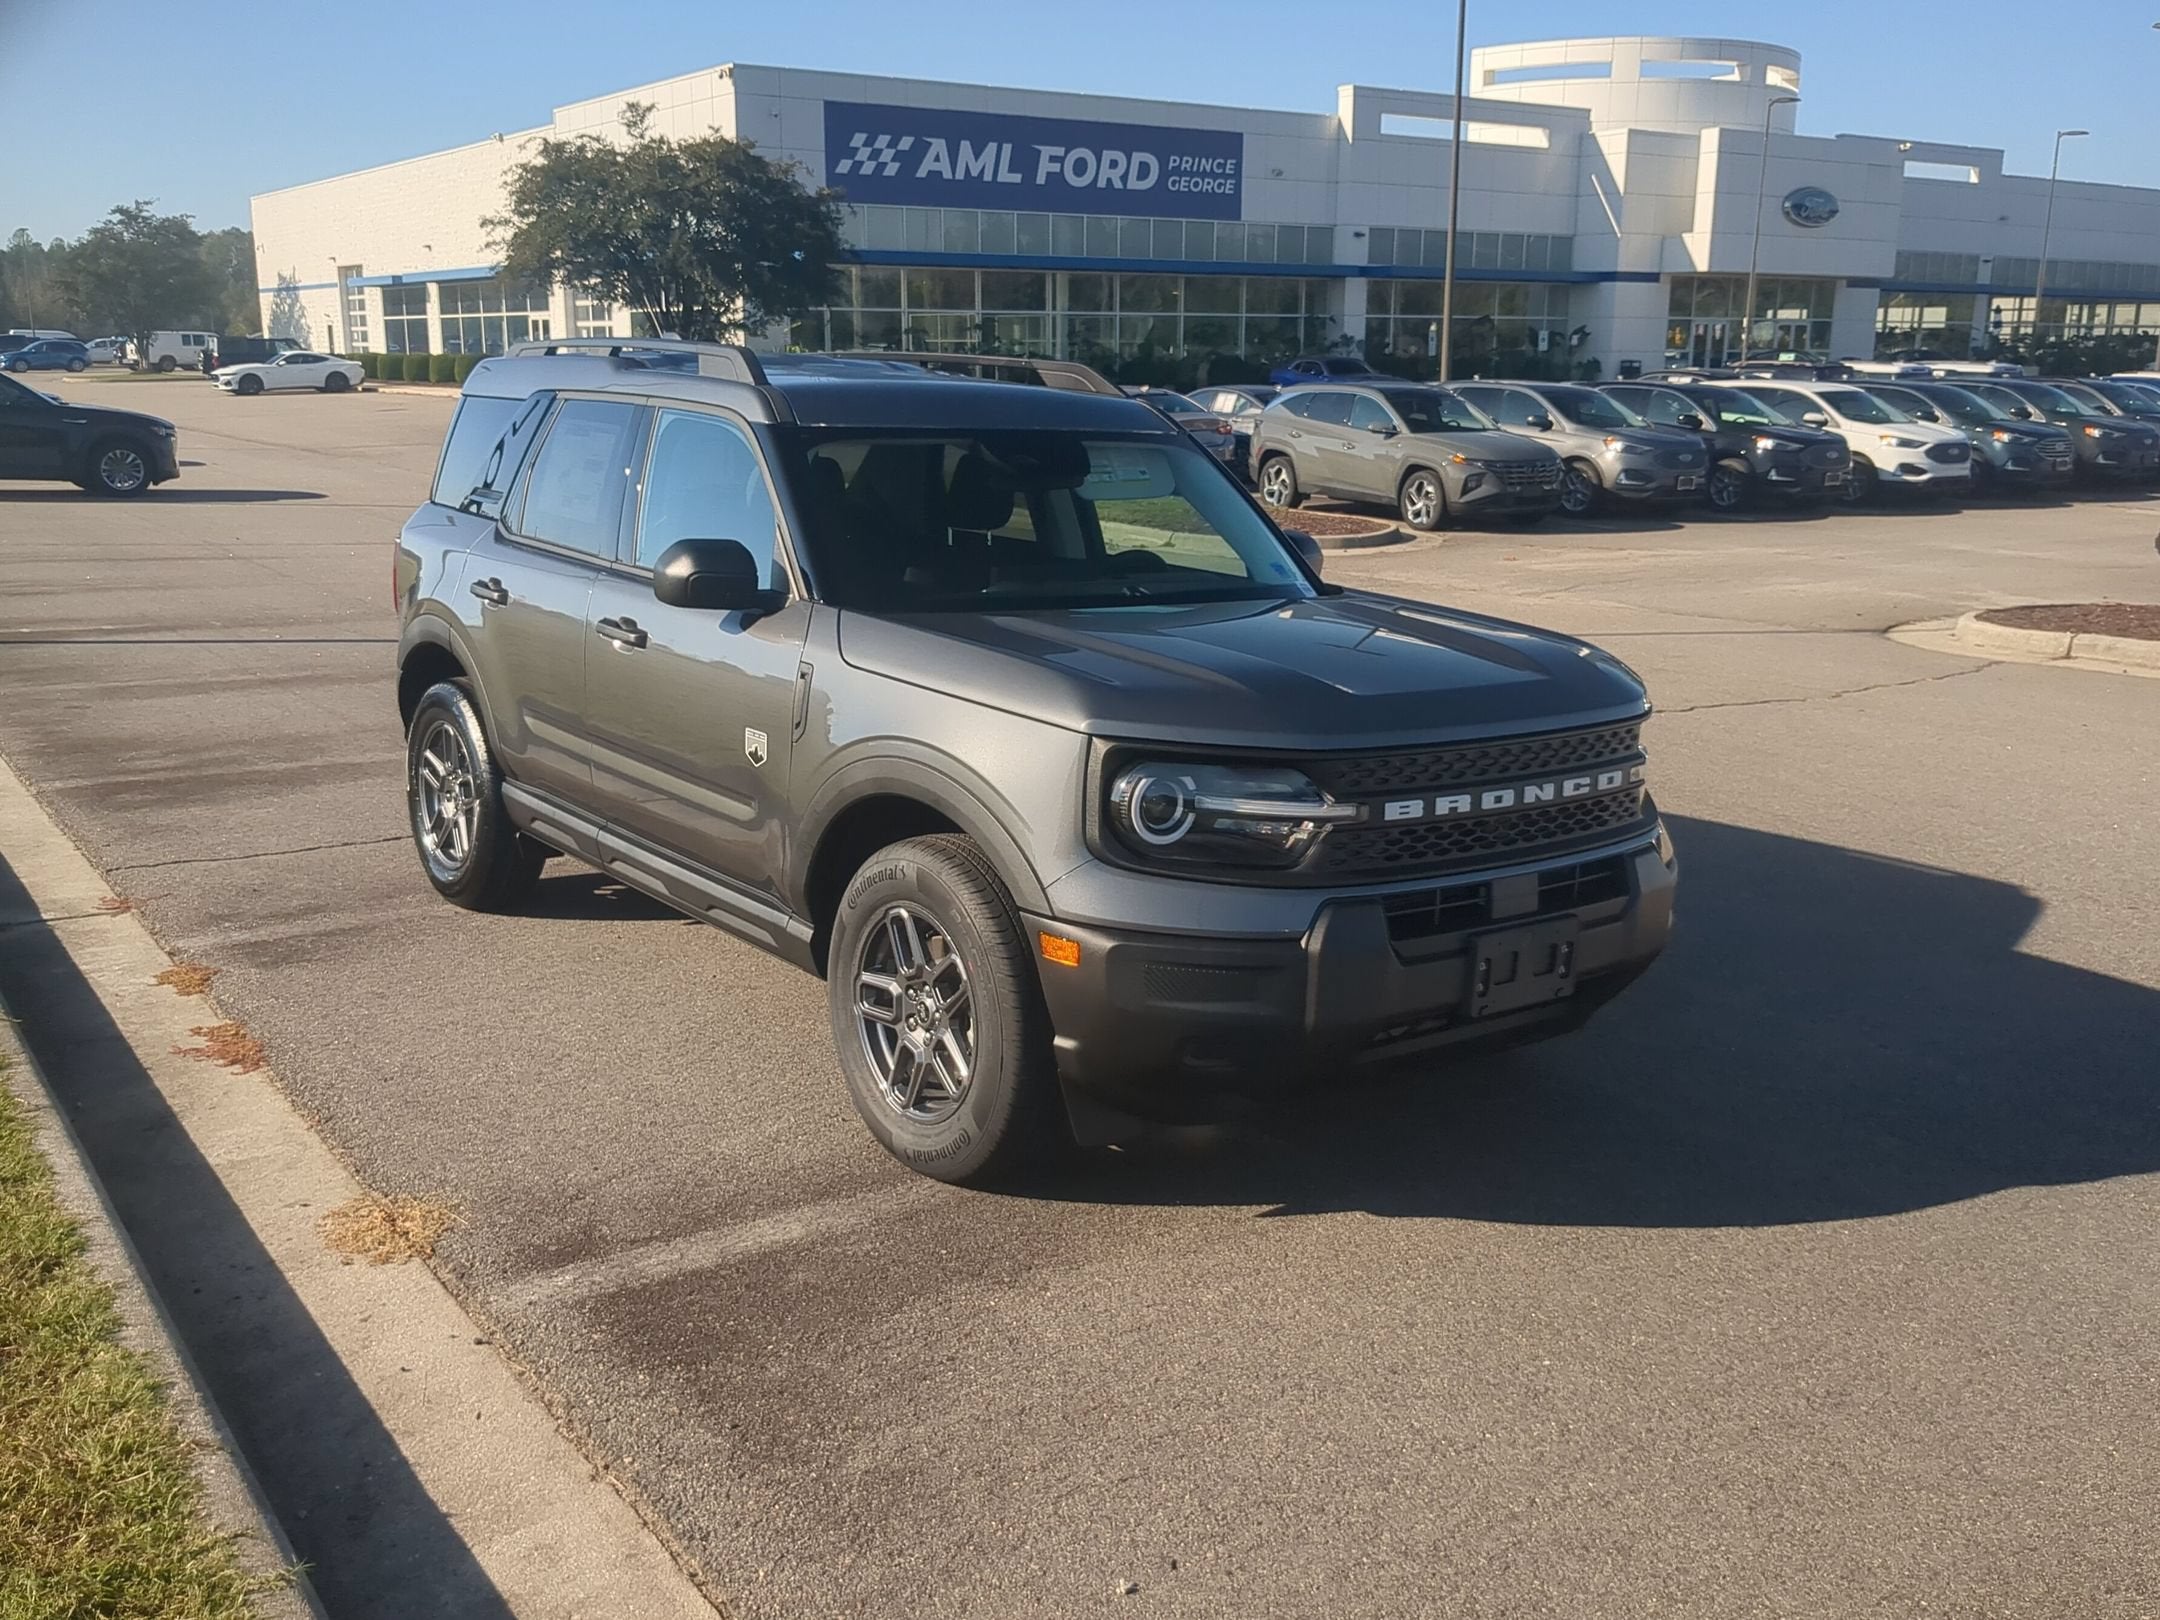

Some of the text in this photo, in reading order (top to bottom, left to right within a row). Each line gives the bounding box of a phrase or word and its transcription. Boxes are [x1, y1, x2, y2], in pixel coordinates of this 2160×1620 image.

[916, 137, 1160, 191] AML FORD
[1168, 155, 1237, 175] PRINCE
[1167, 175, 1236, 194] GEORGE
[1384, 771, 1623, 821] BRONCO
[848, 864, 898, 909] Continental
[913, 1128, 971, 1163] Continental
